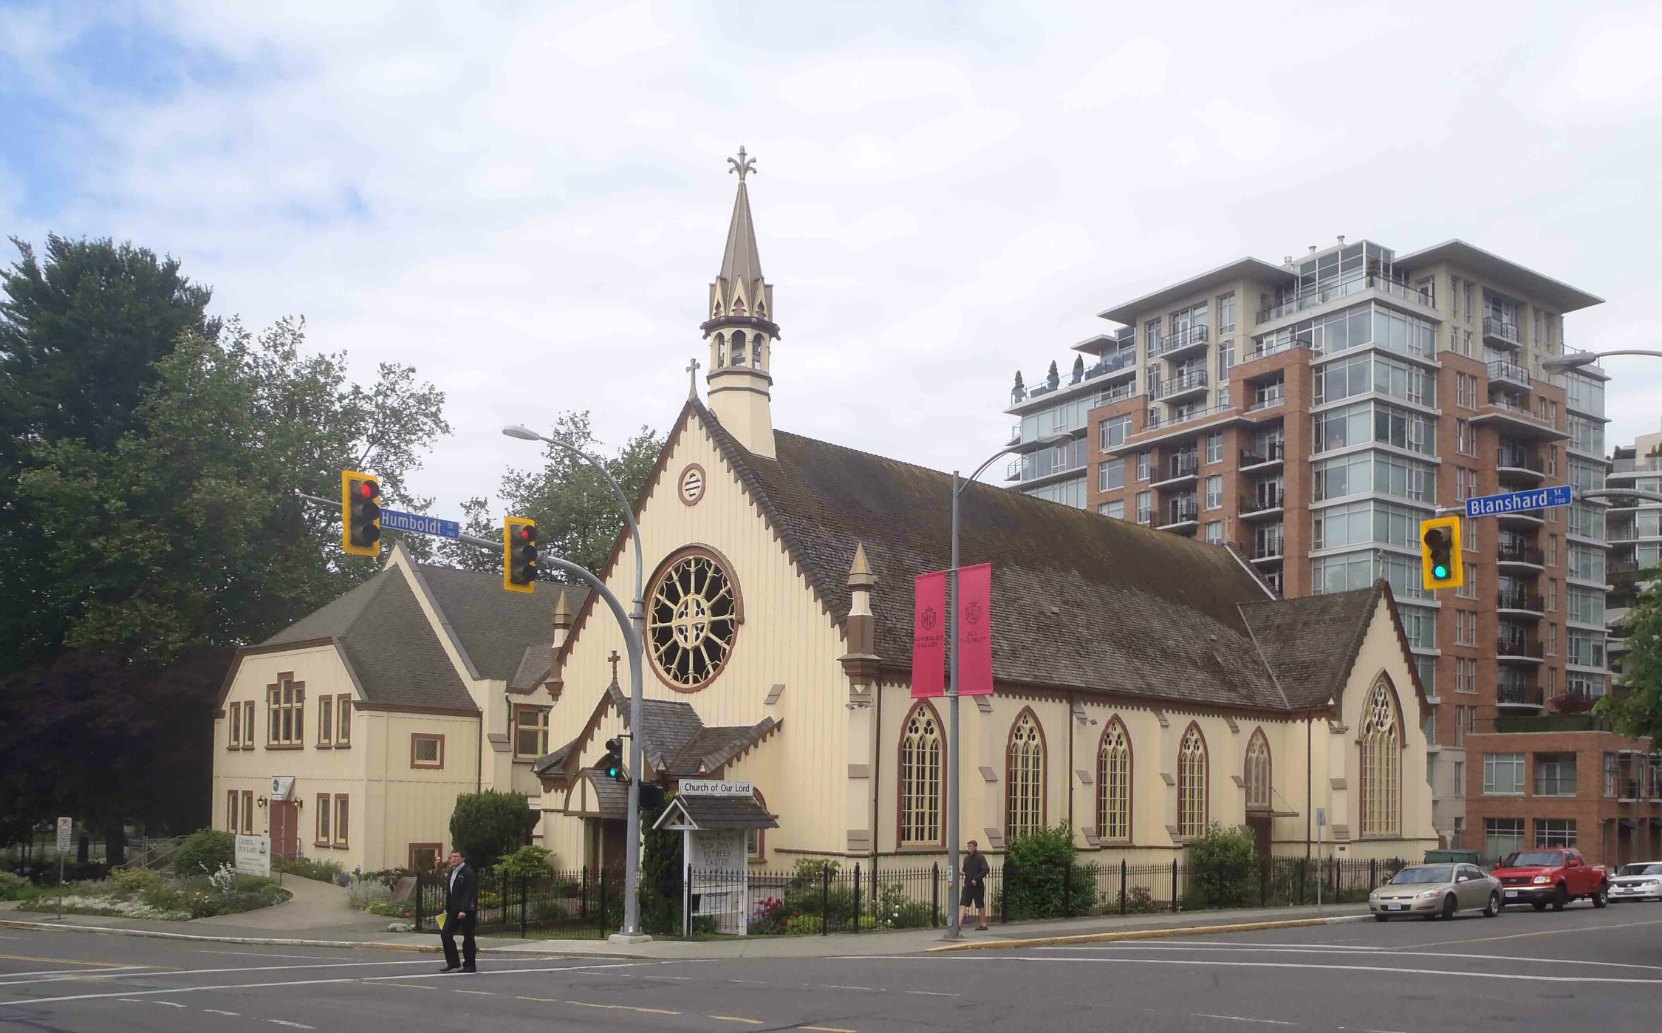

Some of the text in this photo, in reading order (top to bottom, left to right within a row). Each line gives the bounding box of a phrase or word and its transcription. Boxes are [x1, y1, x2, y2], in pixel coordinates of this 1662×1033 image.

[1471, 490, 1548, 515] Blanshard
[381, 511, 442, 534] Humboldt
[684, 782, 750, 792] Church of Our Lord
